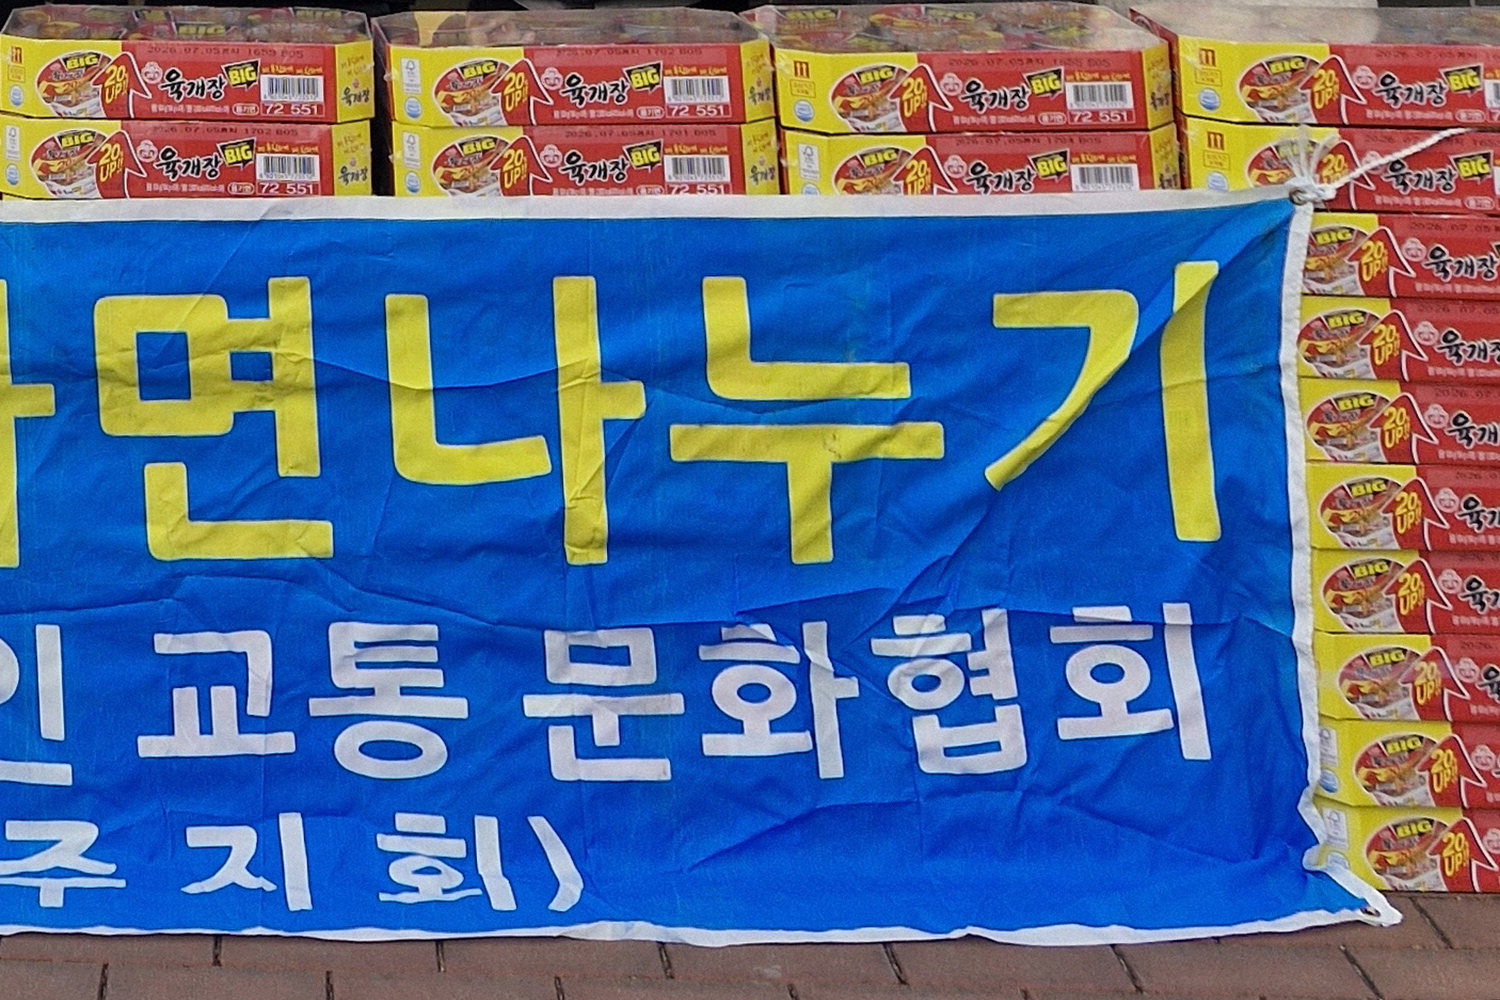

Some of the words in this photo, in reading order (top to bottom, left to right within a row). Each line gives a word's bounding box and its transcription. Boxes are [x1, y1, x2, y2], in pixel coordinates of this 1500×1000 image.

[65, 54, 98, 70] BIG
[462, 62, 496, 79] BIG
[160, 67, 226, 100] 육개장
[227, 67, 257, 85] BIG
[858, 68, 894, 85] BIG
[561, 71, 629, 105] 육개장
[630, 69, 660, 88] BIG
[961, 76, 1030, 111] 육개장
[1030, 75, 1061, 94] BIG
[1375, 72, 1447, 106] 육개장
[1448, 72, 1480, 91] BIG
[265, 103, 283, 113] 72
[291, 103, 317, 115] 551
[669, 105, 689, 116] 72
[696, 104, 724, 116] 551
[1072, 111, 1091, 122] 72
[1099, 110, 1127, 122] 551
[60, 133, 93, 149] BIG
[460, 139, 495, 155] BIG
[156, 146, 222, 178] 육개장
[223, 145, 253, 164] BIG
[561, 149, 629, 183] 육개장
[630, 147, 660, 167] BIG
[862, 150, 897, 167] BIG
[966, 158, 1035, 194] 육개장
[1036, 157, 1067, 176] BIG
[1383, 158, 1456, 192] 육개장
[1456, 158, 1488, 177] BIG
[260, 181, 279, 192] 72
[286, 182, 313, 193] 551
[670, 184, 689, 194] 72
[697, 184, 724, 194] 551
[1316, 229, 1352, 246] BIG
[1424, 246, 1498, 279] 육개장
[1328, 312, 1365, 330] BIG
[1337, 394, 1375, 412] BIG
[1351, 480, 1387, 498] BIG
[1354, 562, 1390, 579] BIG
[138, 623, 467, 777] 교통
[524, 605, 1210, 780] 문화협회
[1386, 737, 1422, 755] BIG
[1396, 821, 1432, 838] BIG
